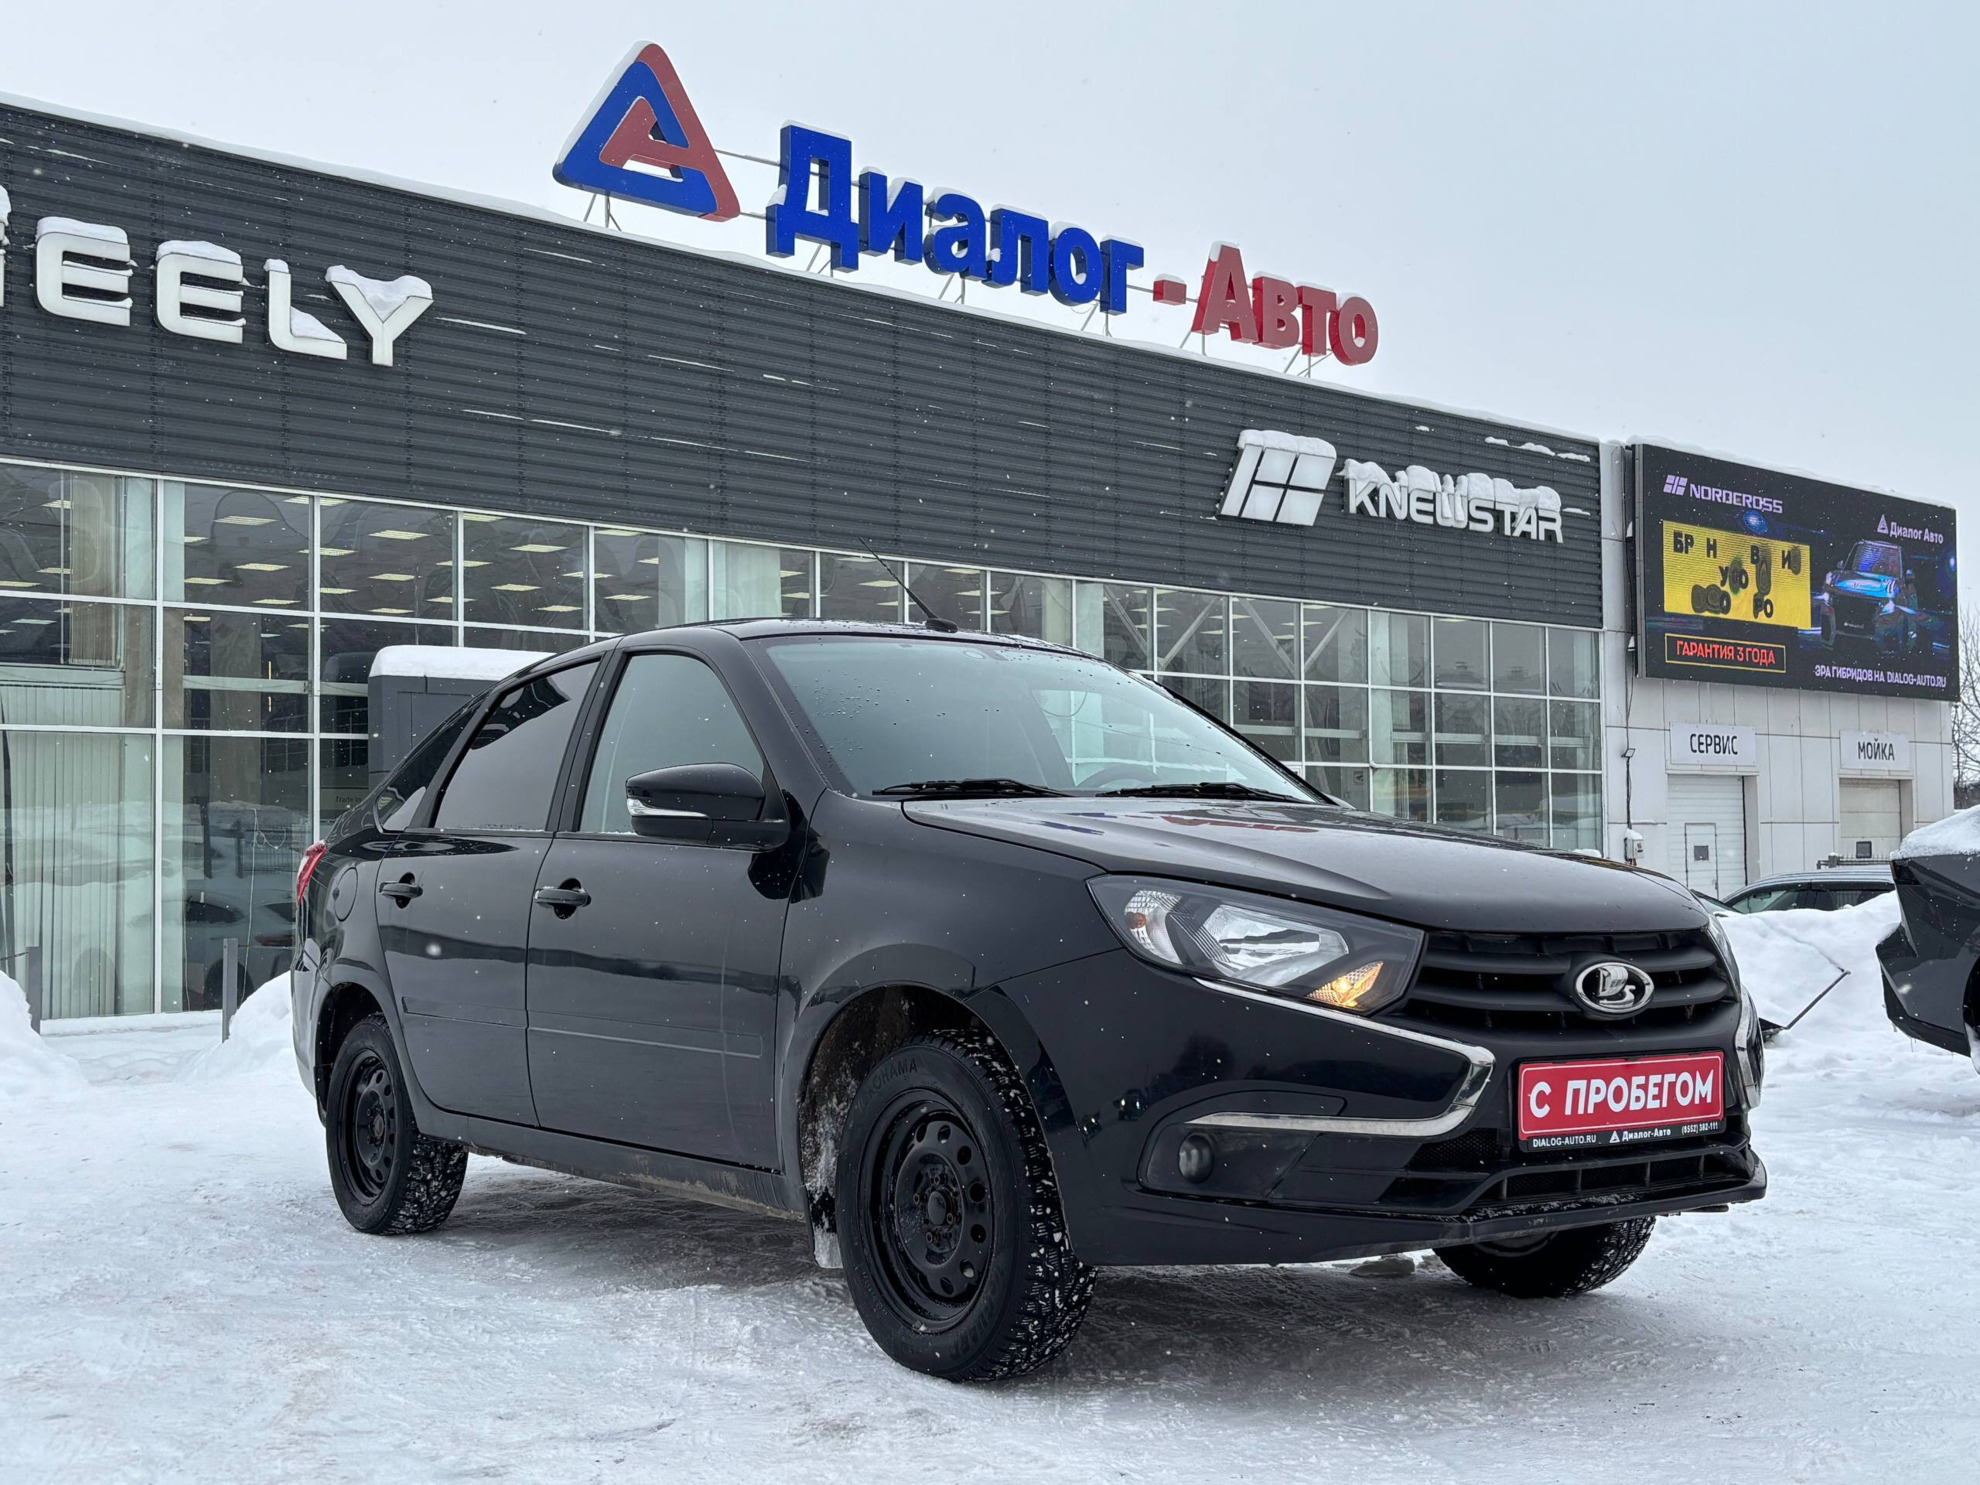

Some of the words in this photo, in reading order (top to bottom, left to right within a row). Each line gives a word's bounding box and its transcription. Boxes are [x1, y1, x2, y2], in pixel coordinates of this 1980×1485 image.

[0, 218, 434, 367] EELY
[1346, 477, 1564, 544] KNEWSTAR
[1890, 521, 1922, 541] Диалог
[1923, 528, 1944, 544] Авто
[1676, 640, 1735, 661] ГАРАНТИЯ
[1737, 649, 1744, 662] 3
[1746, 649, 1776, 665] ГОДА
[1814, 664, 1831, 678] ЭРА
[1832, 666, 1873, 683] ГИБРИДОВ
[1874, 670, 1885, 683] НА
[1887, 671, 1947, 688] DIALOG-AUTO.RU
[1689, 733, 1739, 756] СЕРВИС
[1857, 737, 1895, 761] МОЙКА
[1529, 1081, 1552, 1118] С
[1564, 1069, 1715, 1116] ПРОБЕГОМ
[1532, 1134, 1597, 1148] DIALOG-AUTO.RU
[1622, 1128, 1672, 1141] Диалог-Авто
